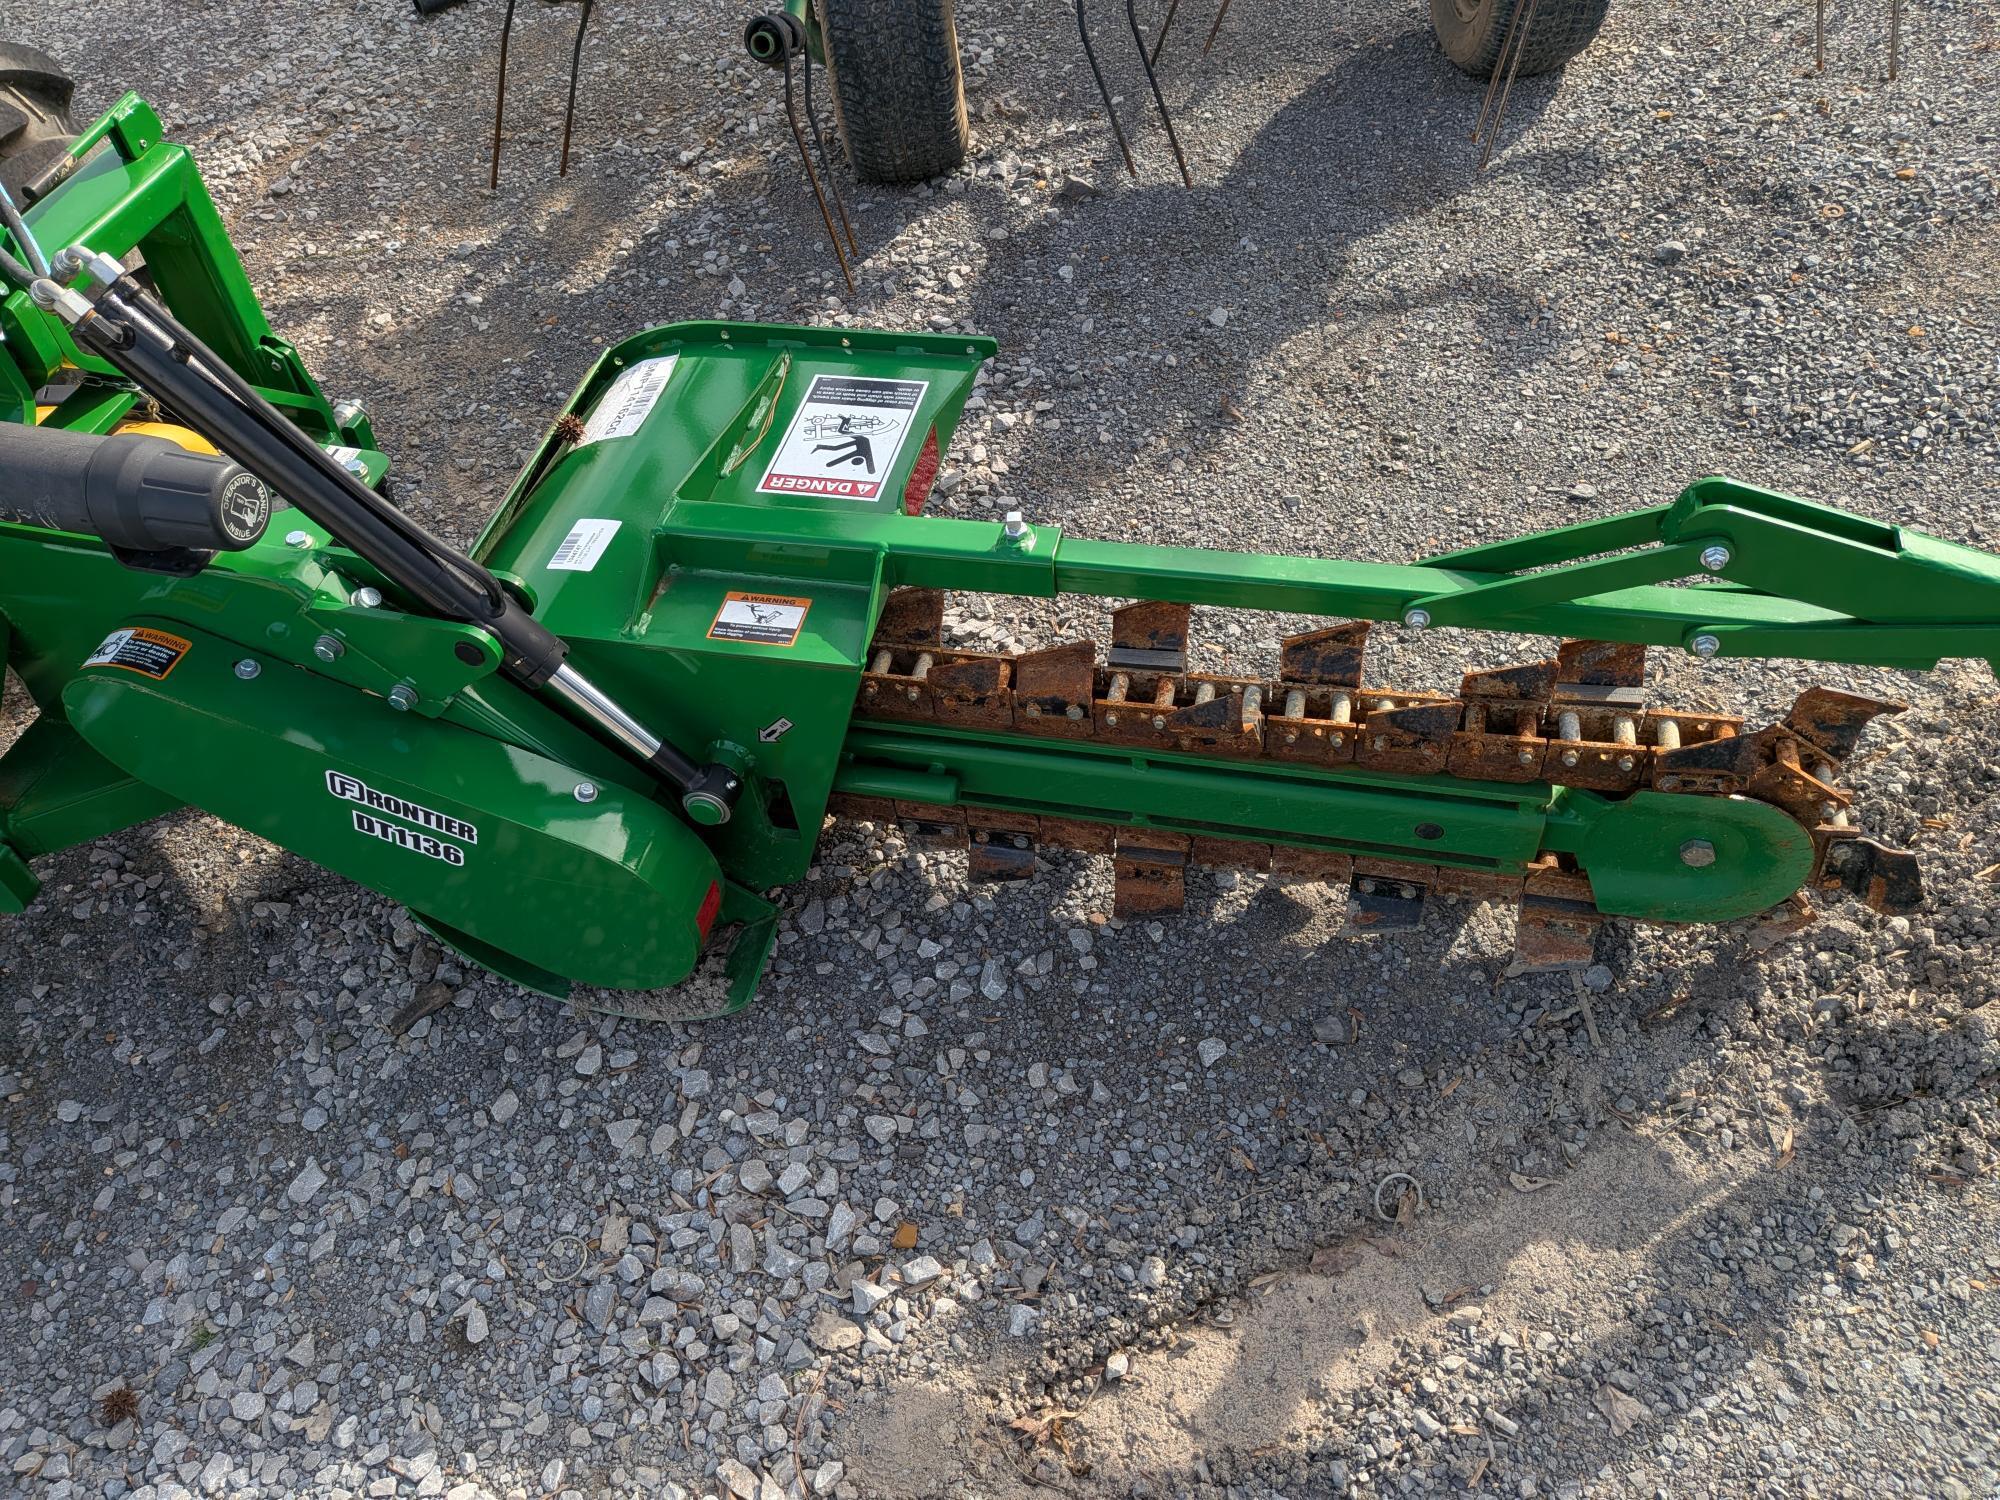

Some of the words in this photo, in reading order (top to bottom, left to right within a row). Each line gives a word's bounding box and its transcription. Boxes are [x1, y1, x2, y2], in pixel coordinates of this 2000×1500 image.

[770, 476, 853, 492] DANGER
[223, 476, 257, 510] OPERATOR'S
[256, 486, 267, 523] MANUAL
[228, 521, 251, 537] INSIDE
[750, 595, 797, 605] WARNING
[145, 632, 186, 650] WARNING
[122, 643, 140, 651] injury
[146, 648, 171, 658] death:
[150, 644, 177, 655] serious
[328, 772, 477, 843] FRONTIER
[355, 812, 463, 865] DT1136
